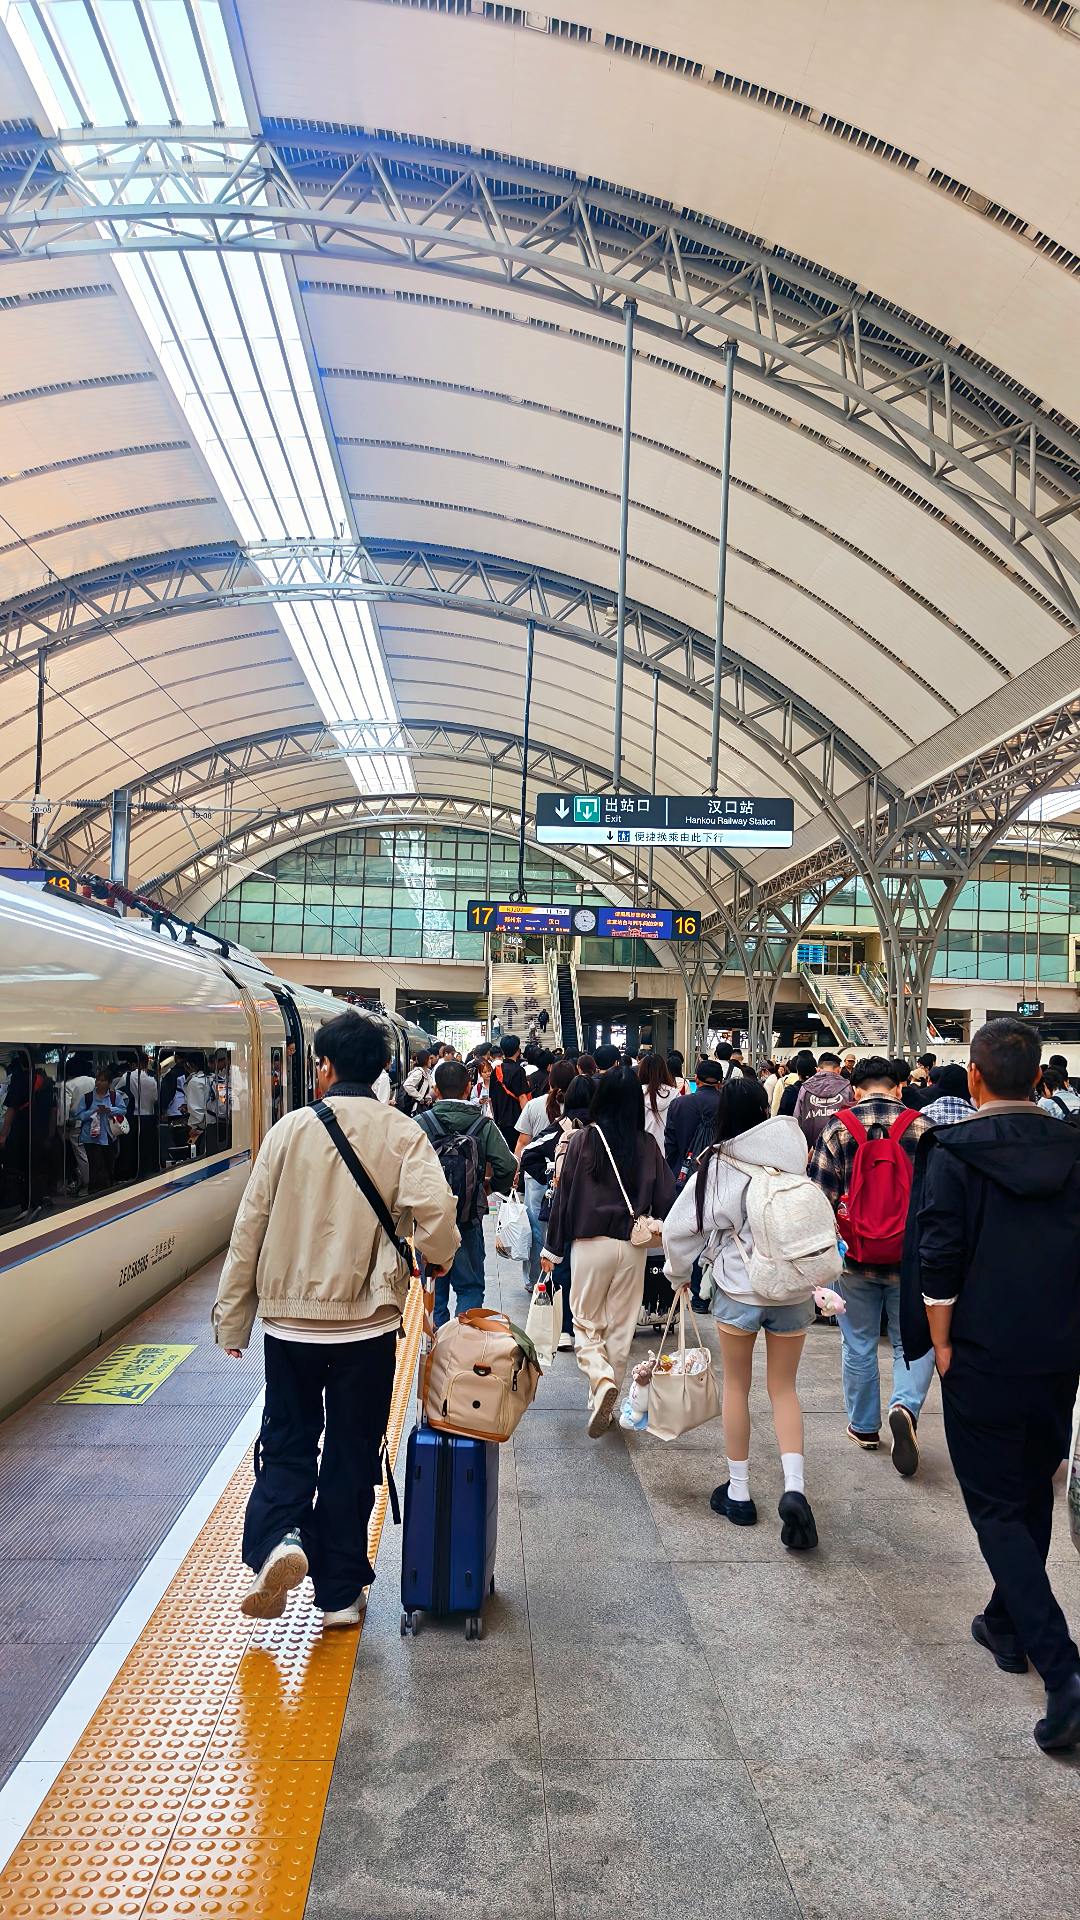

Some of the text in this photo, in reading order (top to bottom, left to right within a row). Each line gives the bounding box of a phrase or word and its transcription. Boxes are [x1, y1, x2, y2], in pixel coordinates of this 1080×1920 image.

[605, 797, 650, 813] 出站口
[707, 799, 755, 815] 汉口站
[605, 814, 622, 823] Exit
[685, 816, 776, 827] Hankou Railway Station
[635, 831, 724, 843] 便捷换乘由此下行
[472, 906, 494, 925] 17
[675, 916, 696, 935] 16
